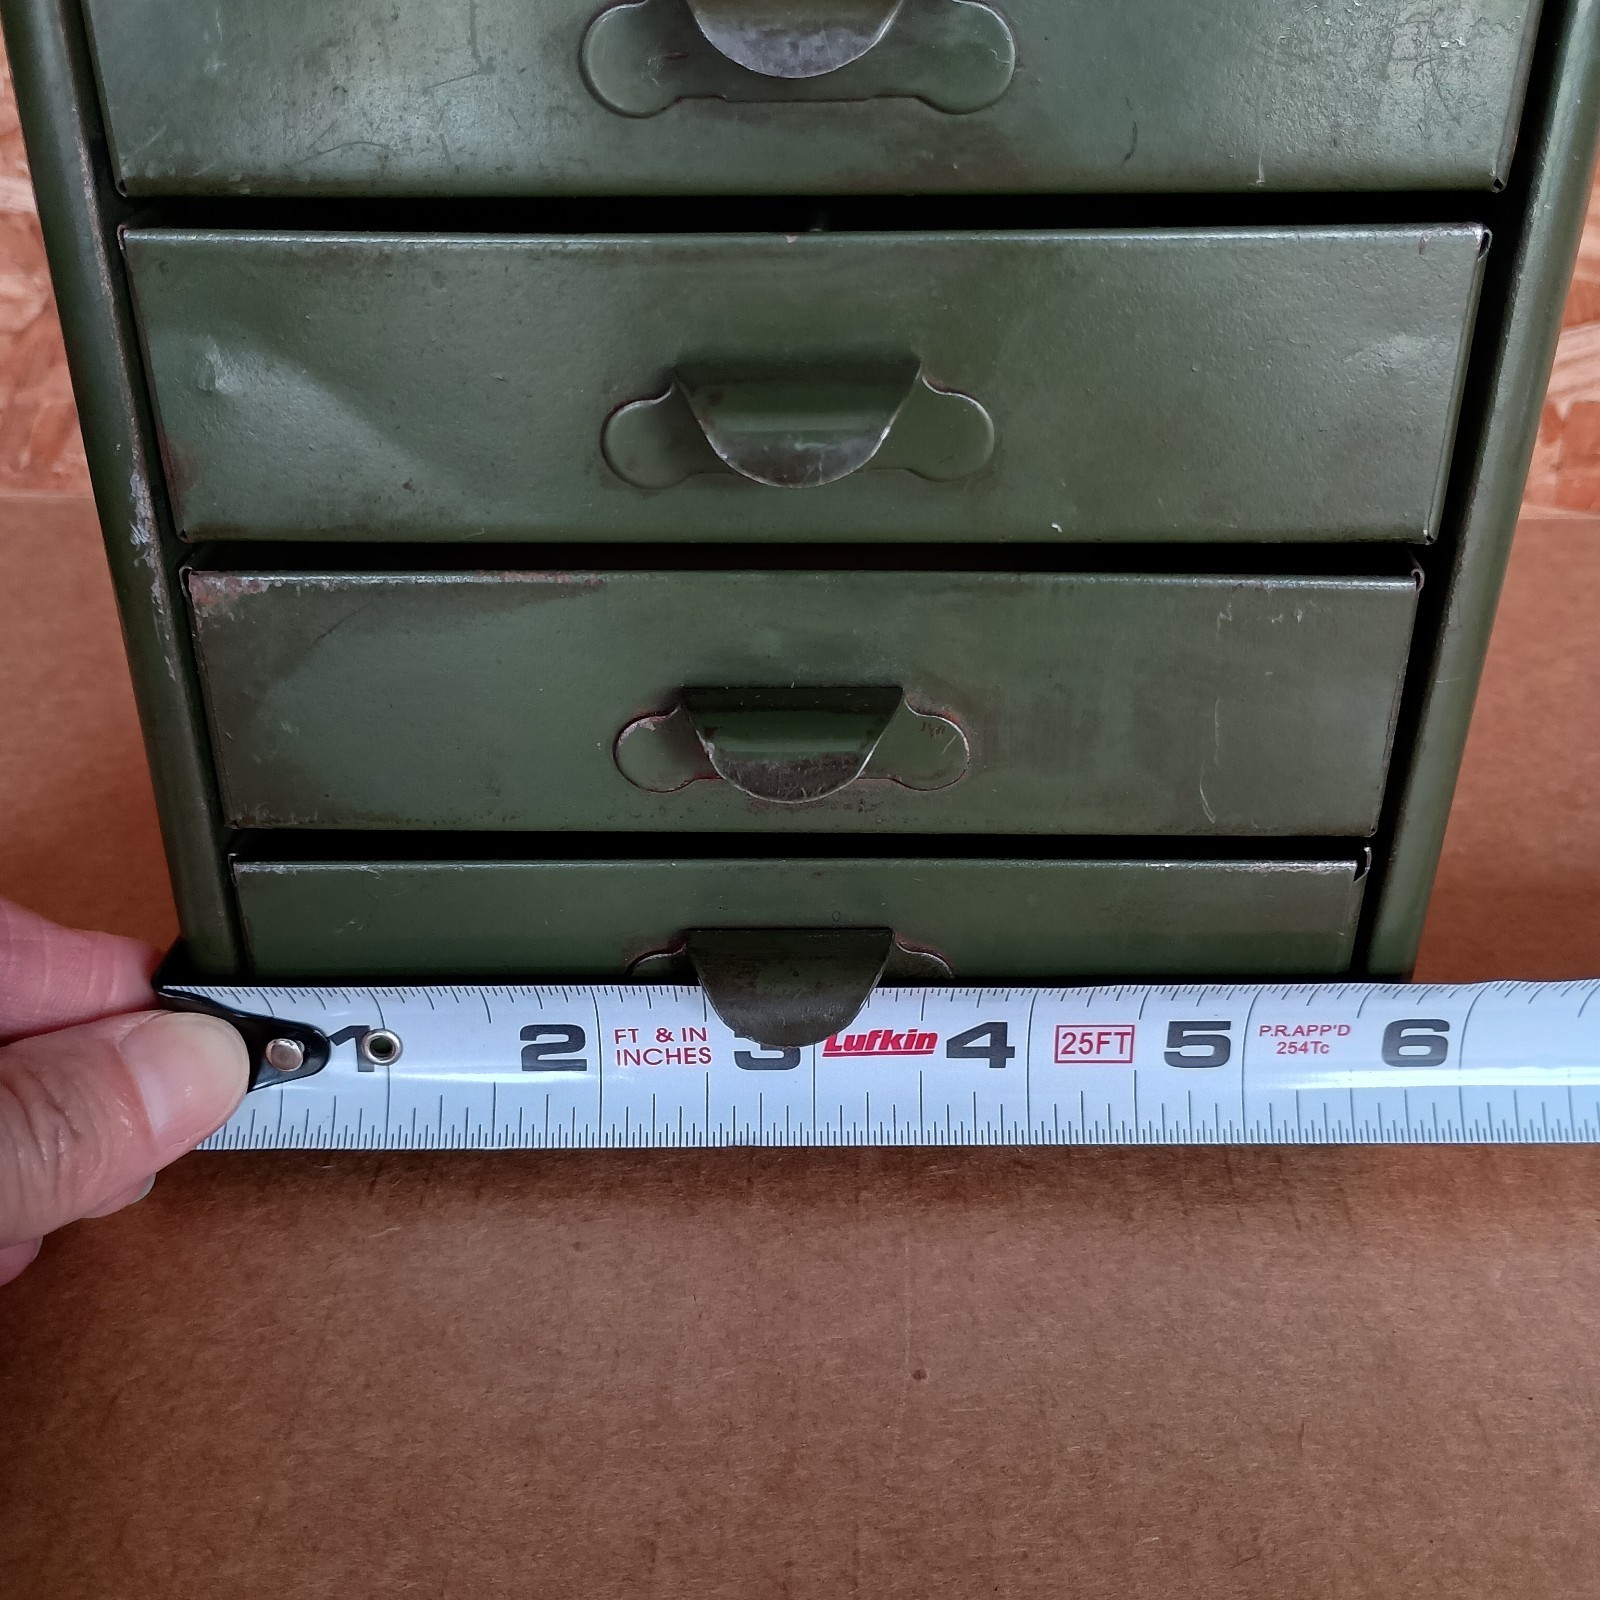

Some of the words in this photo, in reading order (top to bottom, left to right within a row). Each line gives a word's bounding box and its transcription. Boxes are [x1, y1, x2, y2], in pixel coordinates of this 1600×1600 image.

[519, 1023, 588, 1072] 2
[614, 1028, 639, 1044] FT
[655, 1027, 674, 1044] &
[681, 1026, 708, 1043] IN
[822, 1028, 939, 1053] Lufkin
[945, 1021, 1016, 1069] 4
[1060, 1031, 1132, 1055] 25FT
[1163, 1020, 1232, 1068] 5
[1380, 1018, 1451, 1068] 6
[615, 1046, 713, 1066] INCHES
[1275, 1041, 1331, 1056] 254Tc
